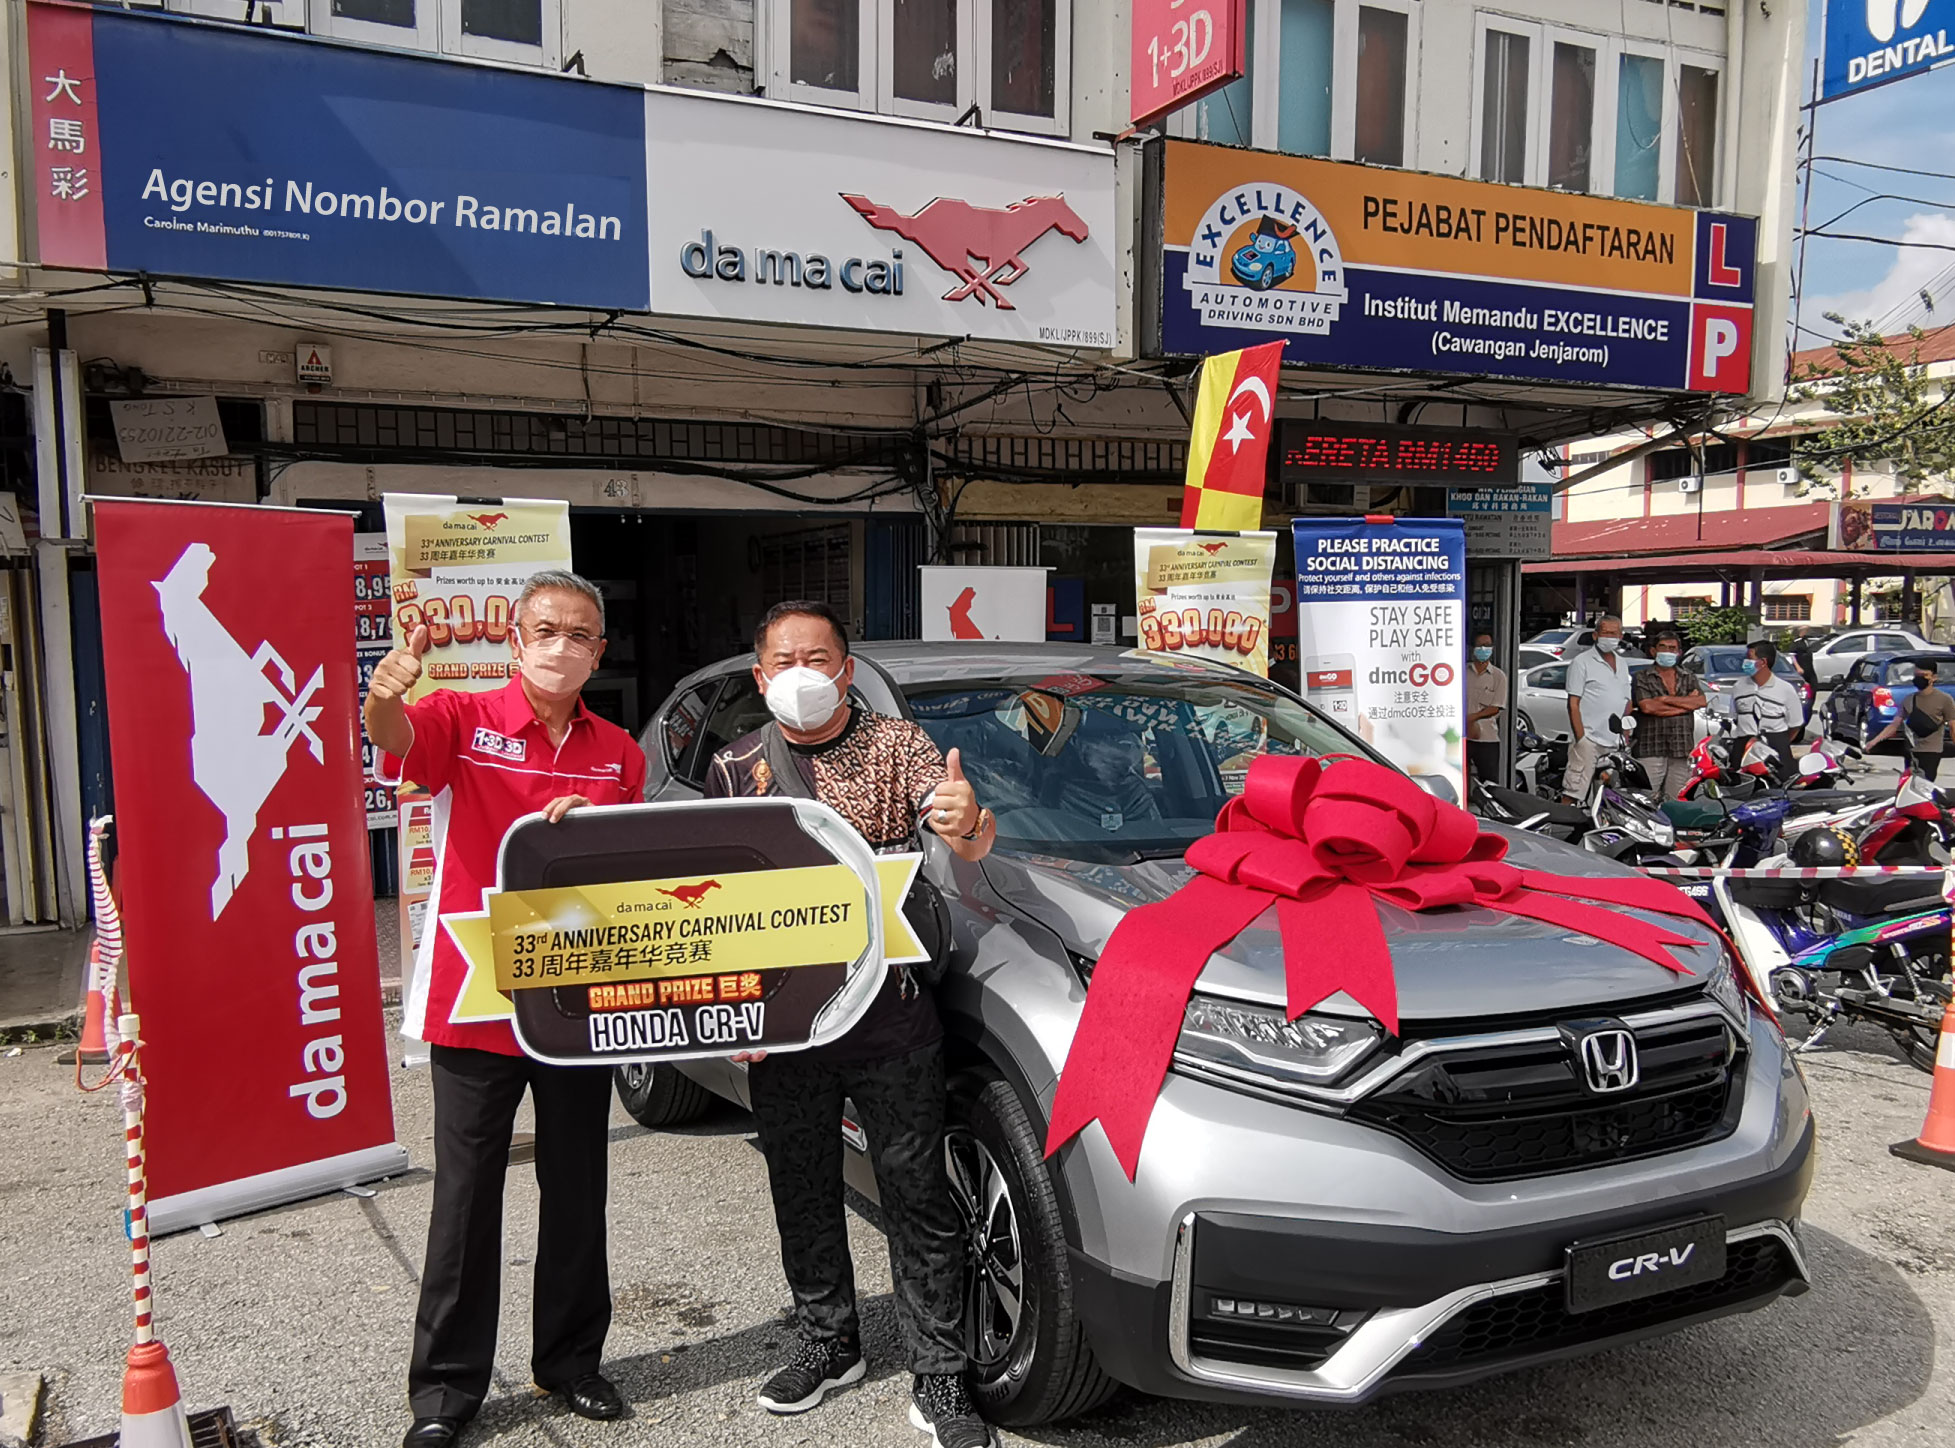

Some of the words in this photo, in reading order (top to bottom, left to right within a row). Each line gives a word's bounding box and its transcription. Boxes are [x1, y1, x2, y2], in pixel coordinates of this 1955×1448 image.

[1147, 9, 1213, 88] 1+3D
[1848, 28, 1955, 84] DENTAL
[44, 68, 90, 201] 大馬彩
[141, 168, 274, 212] Agensi
[284, 179, 445, 226] Nombor
[454, 194, 622, 242] Ramalan
[143, 216, 194, 232] Caroline
[197, 221, 260, 237] Marimuthu
[1195, 189, 1338, 283] EXCELLENCE
[1362, 194, 1487, 243] PEJABAT
[1494, 210, 1675, 266] PENDAFTARAN
[1708, 222, 1742, 289] L
[1200, 292, 1333, 315] AUTOMOTIVE
[1208, 309, 1263, 323] DRIVING
[1268, 314, 1294, 326] SDN
[1298, 316, 1325, 328] BHD
[1363, 292, 1438, 323] Institut
[1443, 299, 1538, 332] Memandu
[1543, 307, 1670, 343] EXCELLENCE
[1039, 326, 1112, 345] MDKL/JPPK/899(SJ)
[1702, 317, 1738, 379] P
[1430, 329, 1526, 361] (Cawangan
[1529, 334, 1610, 369] Jenjarom)
[1450, 492, 1472, 501] KHOO
[1474, 493, 1490, 501] DAN
[1493, 493, 1548, 503] RAKAN-RAKAN
[435, 536, 481, 548] ANNIVERSARY
[482, 535, 517, 546] CARNIVAL
[518, 533, 550, 544] CONTEST
[1318, 538, 1369, 553] PLEASE
[1372, 538, 1440, 553] PRACTICE
[1307, 556, 1359, 571] SOCIAL
[1362, 555, 1449, 570] DISTANCING
[435, 576, 456, 585] Prizes
[457, 576, 476, 585] worth
[477, 578, 486, 586] up
[486, 577, 495, 585] to
[1298, 573, 1323, 582] Protect
[1324, 572, 1354, 583] yourself
[1355, 572, 1371, 582] and
[1372, 572, 1395, 581] others
[1396, 572, 1423, 583] against
[1424, 571, 1461, 581] infections
[392, 580, 419, 604] RM
[1370, 606, 1408, 626] STAY
[1413, 605, 1452, 625] SAFE
[1369, 628, 1409, 648] PLAY
[1414, 628, 1453, 647] SAFE
[1401, 650, 1421, 662] with
[427, 663, 469, 680] GRAND
[471, 661, 505, 680] PRIZE
[1368, 662, 1455, 688] dmcGO
[1394, 690, 1429, 704] 注意安全
[513, 932, 548, 955] 33rd
[550, 920, 676, 951] ANNIVERSARY
[679, 911, 767, 939] CARNIVAL
[770, 902, 852, 930] CONTEST
[512, 958, 535, 978] 33
[539, 939, 713, 979] 周年嘉年华竞赛
[588, 981, 655, 1010] GRAND
[659, 976, 714, 1004] PRIZE
[718, 972, 762, 1000] 巨奖
[589, 1008, 689, 1052] HONDA
[695, 1002, 765, 1043] CR-V
[1606, 1242, 1695, 1282] CR-V
